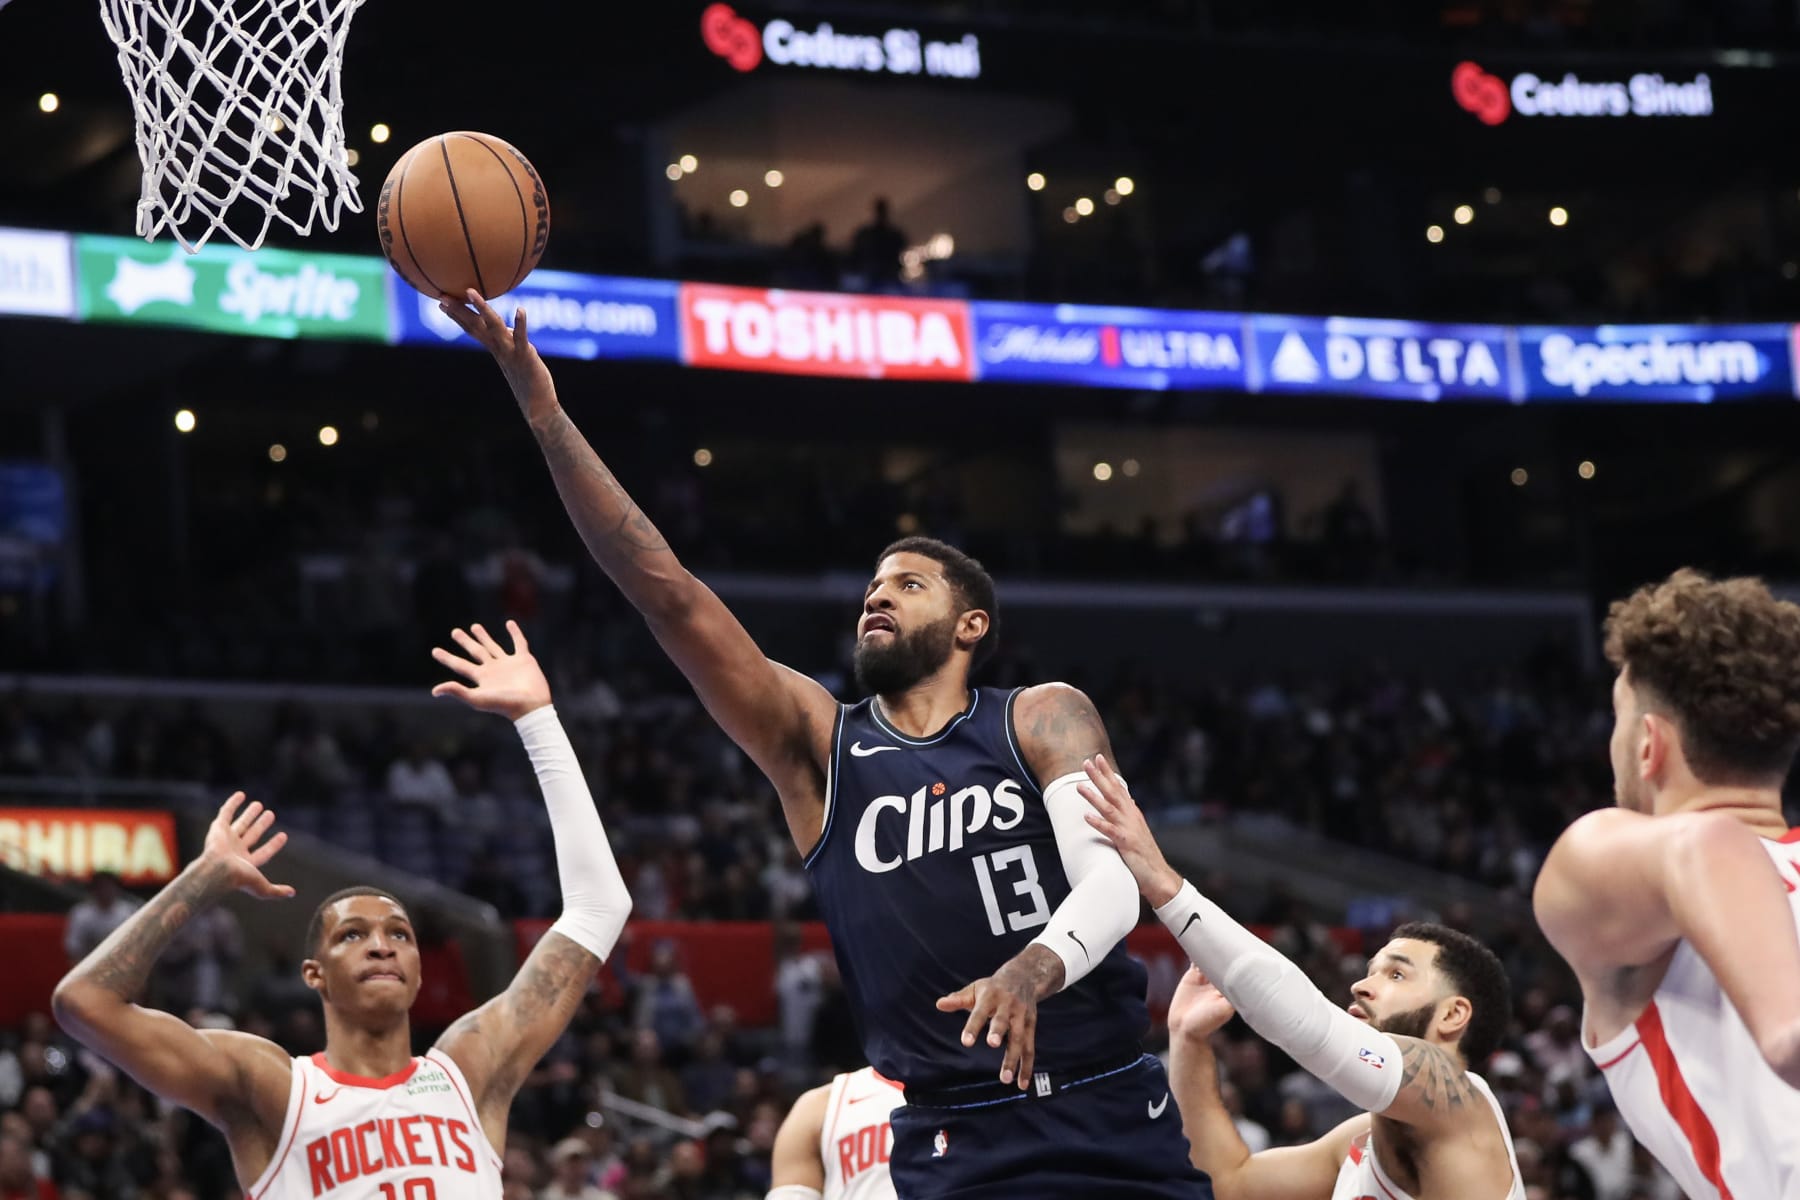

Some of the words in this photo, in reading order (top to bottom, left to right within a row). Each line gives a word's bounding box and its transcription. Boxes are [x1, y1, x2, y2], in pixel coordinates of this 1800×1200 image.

[763, 19, 885, 72] Cedars
[1510, 72, 1630, 116] Cedars
[219, 260, 360, 323] Sprite
[694, 300, 962, 367] TOSHIBA
[1120, 329, 1240, 370] ULTRA
[1325, 336, 1500, 387] DELTA
[1540, 334, 1759, 396] Spectrum
[855, 779, 1024, 873] Clips
[972, 844, 1051, 936] 13
[306, 1115, 477, 1198] ROCKETS
